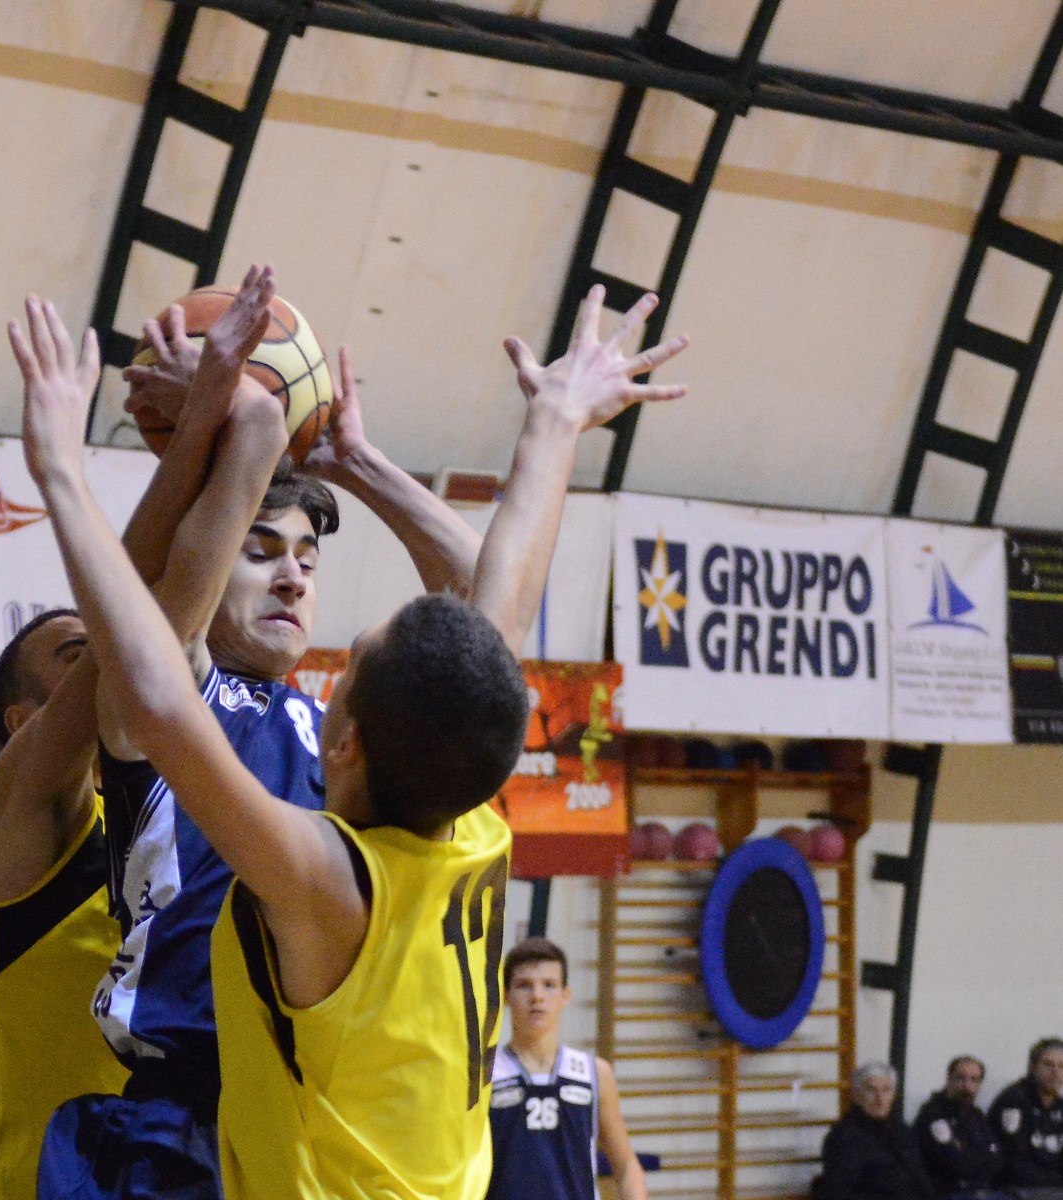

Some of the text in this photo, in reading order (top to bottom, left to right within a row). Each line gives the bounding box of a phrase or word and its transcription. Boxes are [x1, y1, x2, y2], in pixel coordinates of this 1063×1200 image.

[700, 543, 874, 616] GRUPPO
[698, 611, 877, 680] GRENDI
[525, 1096, 560, 1130] 26
